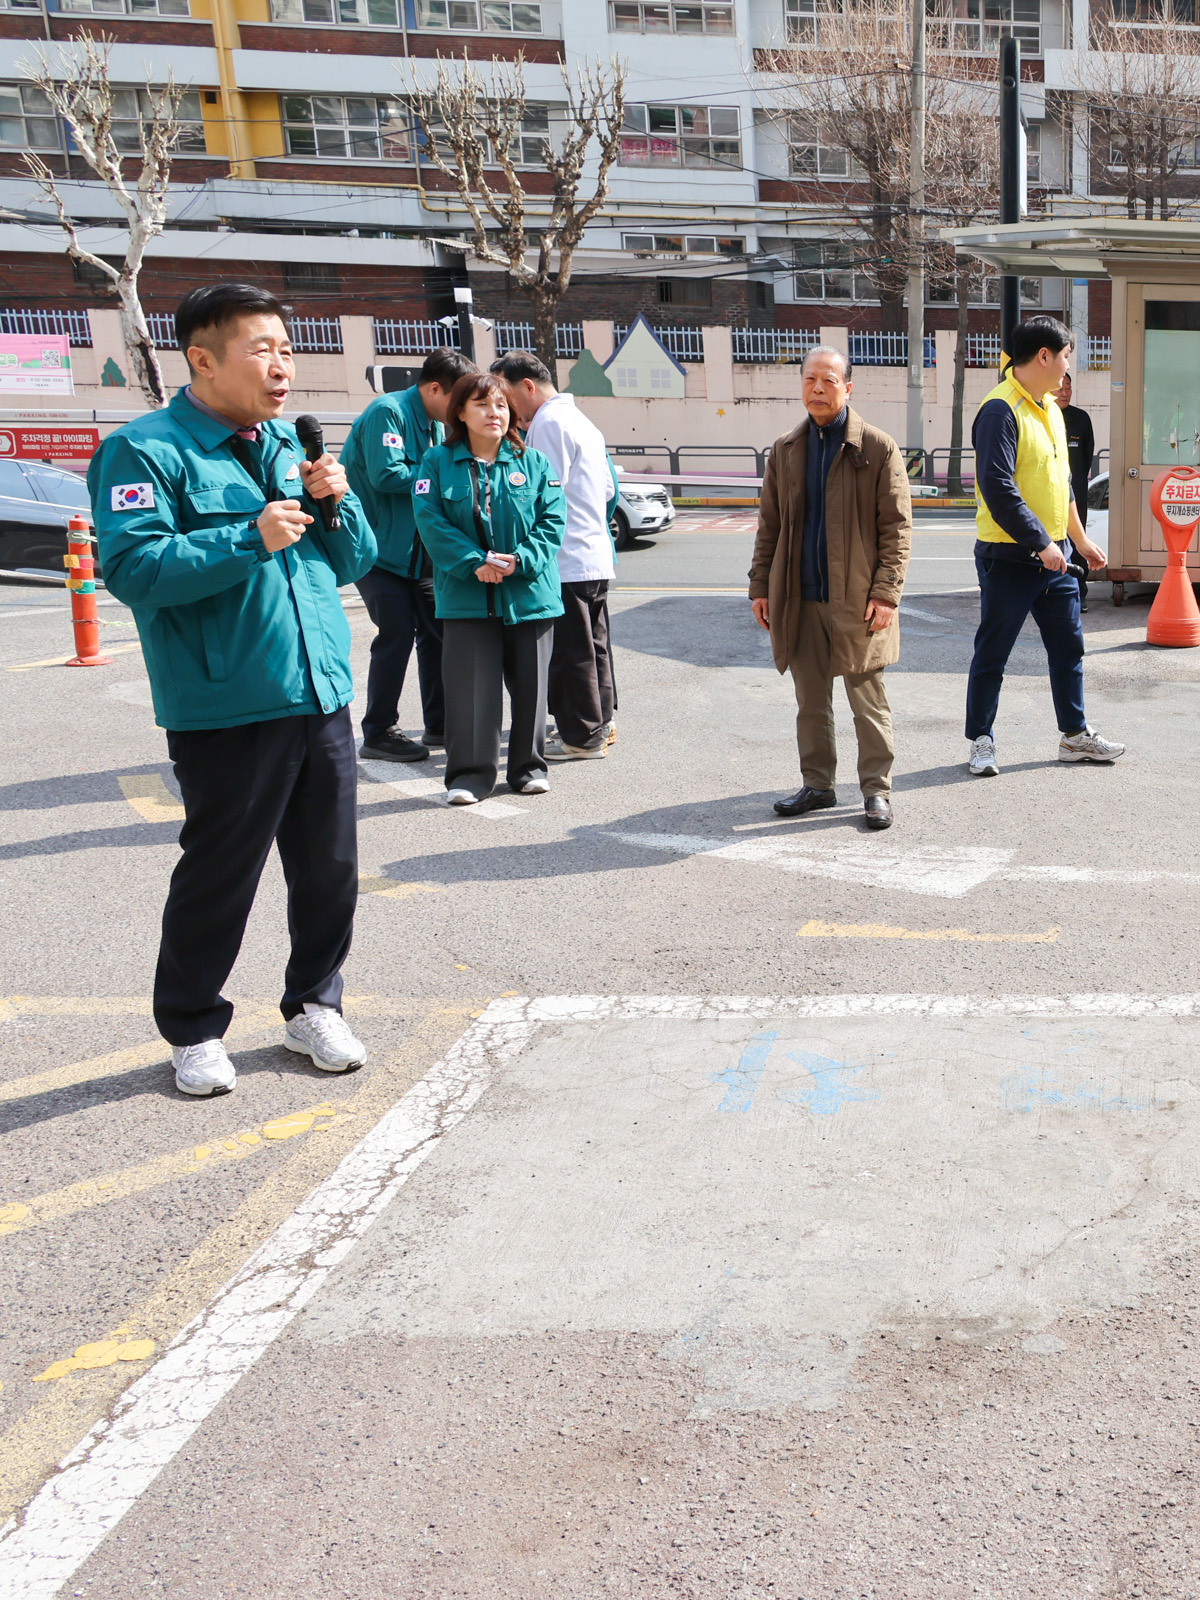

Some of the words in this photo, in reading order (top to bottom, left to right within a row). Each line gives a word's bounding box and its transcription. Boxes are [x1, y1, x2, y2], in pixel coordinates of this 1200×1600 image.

[21, 434, 51, 443] 주차걱정
[63, 434, 93, 443] 아이파킹
[1166, 505, 1200, 517] 무지개쇼핑센터
